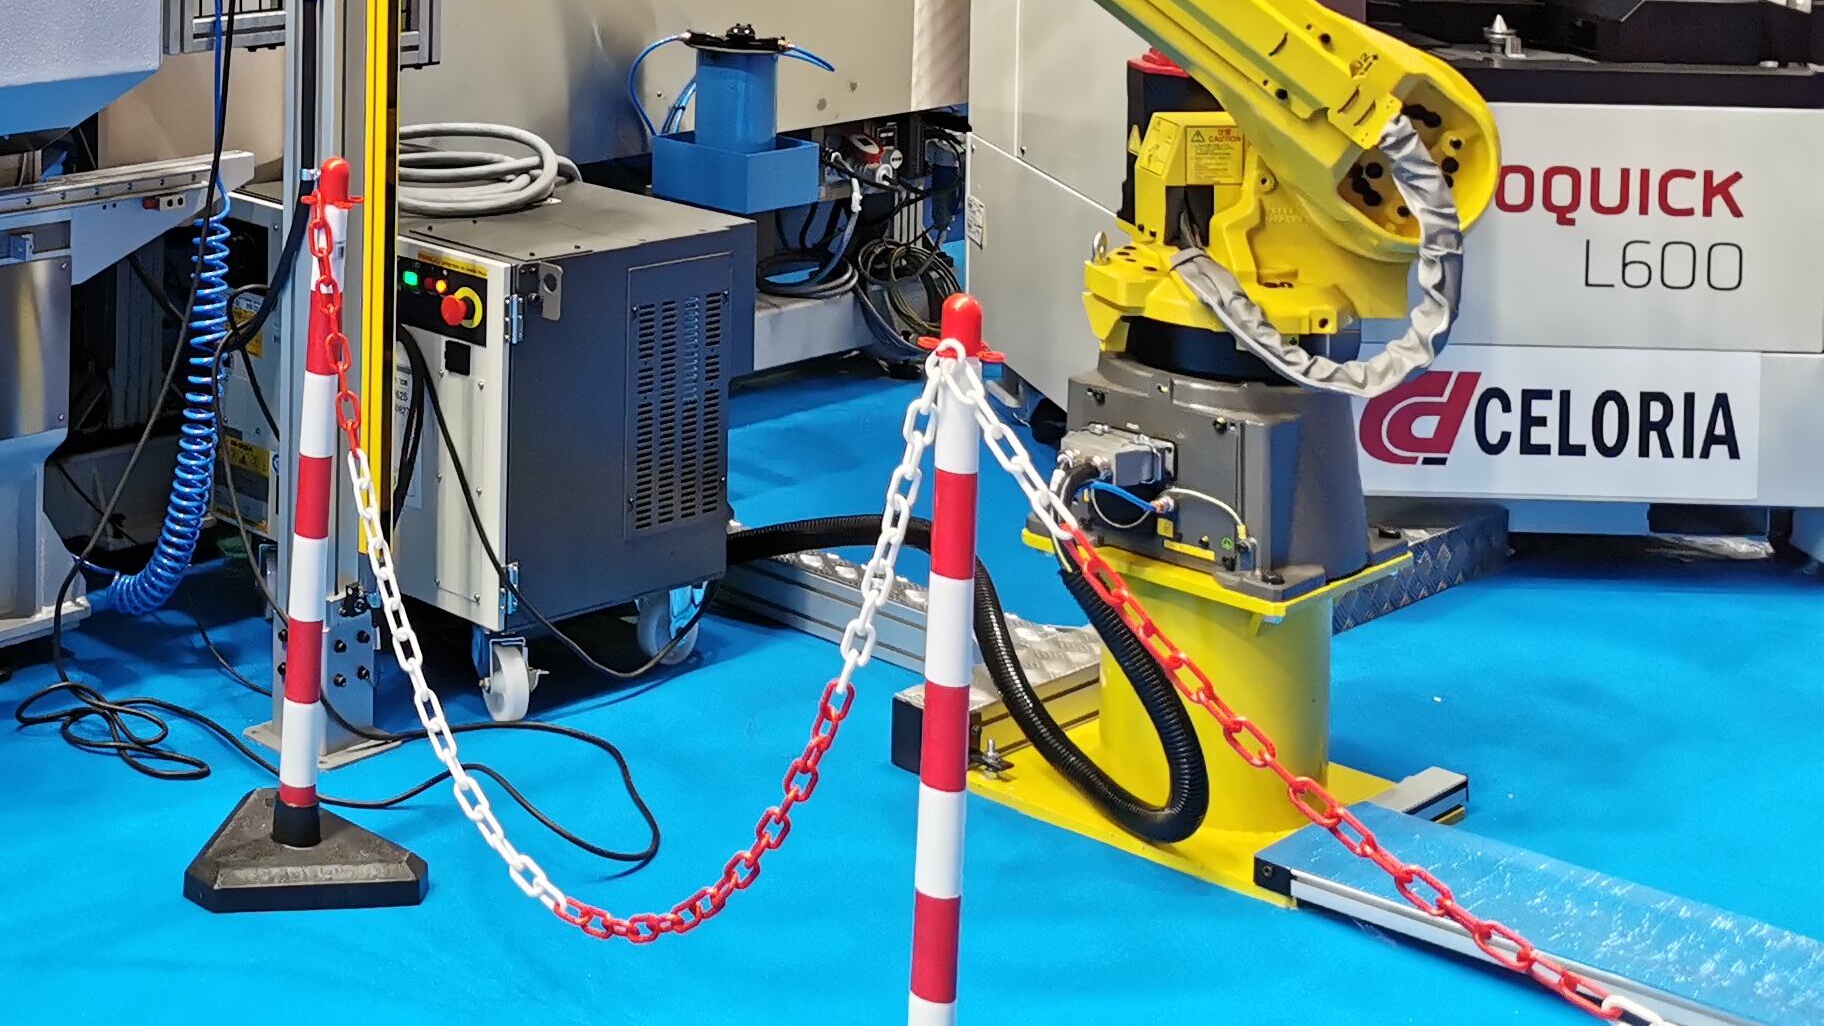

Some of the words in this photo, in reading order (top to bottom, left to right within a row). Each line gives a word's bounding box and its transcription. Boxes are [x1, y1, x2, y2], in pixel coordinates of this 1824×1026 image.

[1207, 135, 1241, 143] CAUTION
[1495, 164, 1746, 226] OQUICK
[1584, 240, 1744, 293] L600
[1474, 386, 1742, 464] CELORIA
